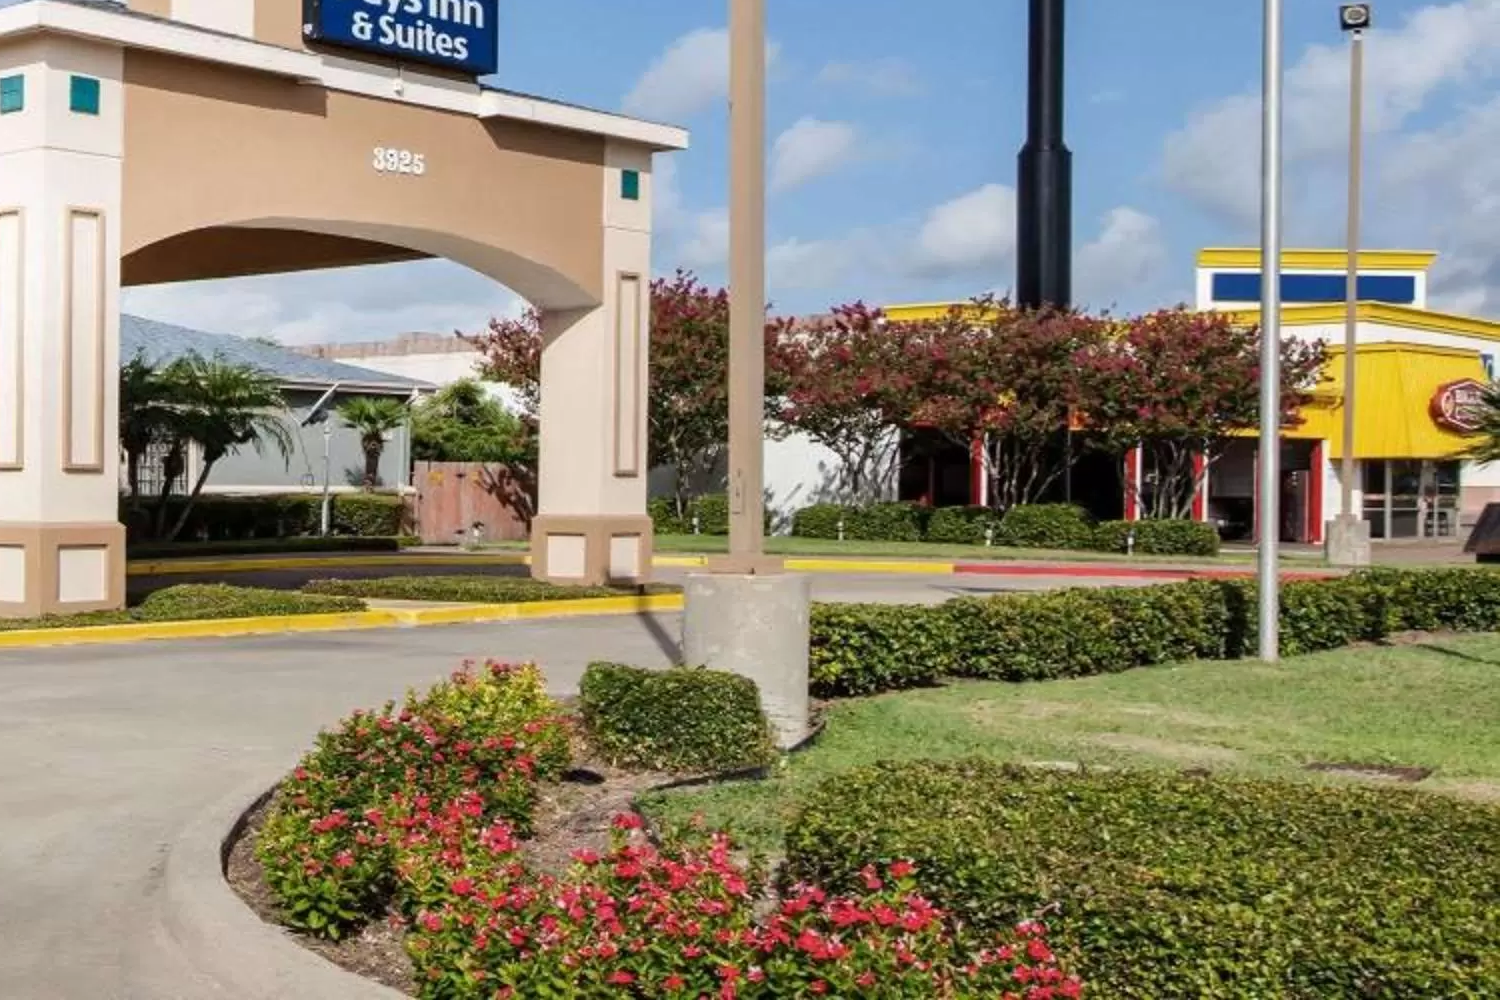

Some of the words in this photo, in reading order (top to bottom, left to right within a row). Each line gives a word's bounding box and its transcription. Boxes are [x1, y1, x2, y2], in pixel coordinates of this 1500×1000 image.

[351, 11, 373, 41] &
[379, 14, 468, 60] Suites
[372, 147, 425, 174] 3925
